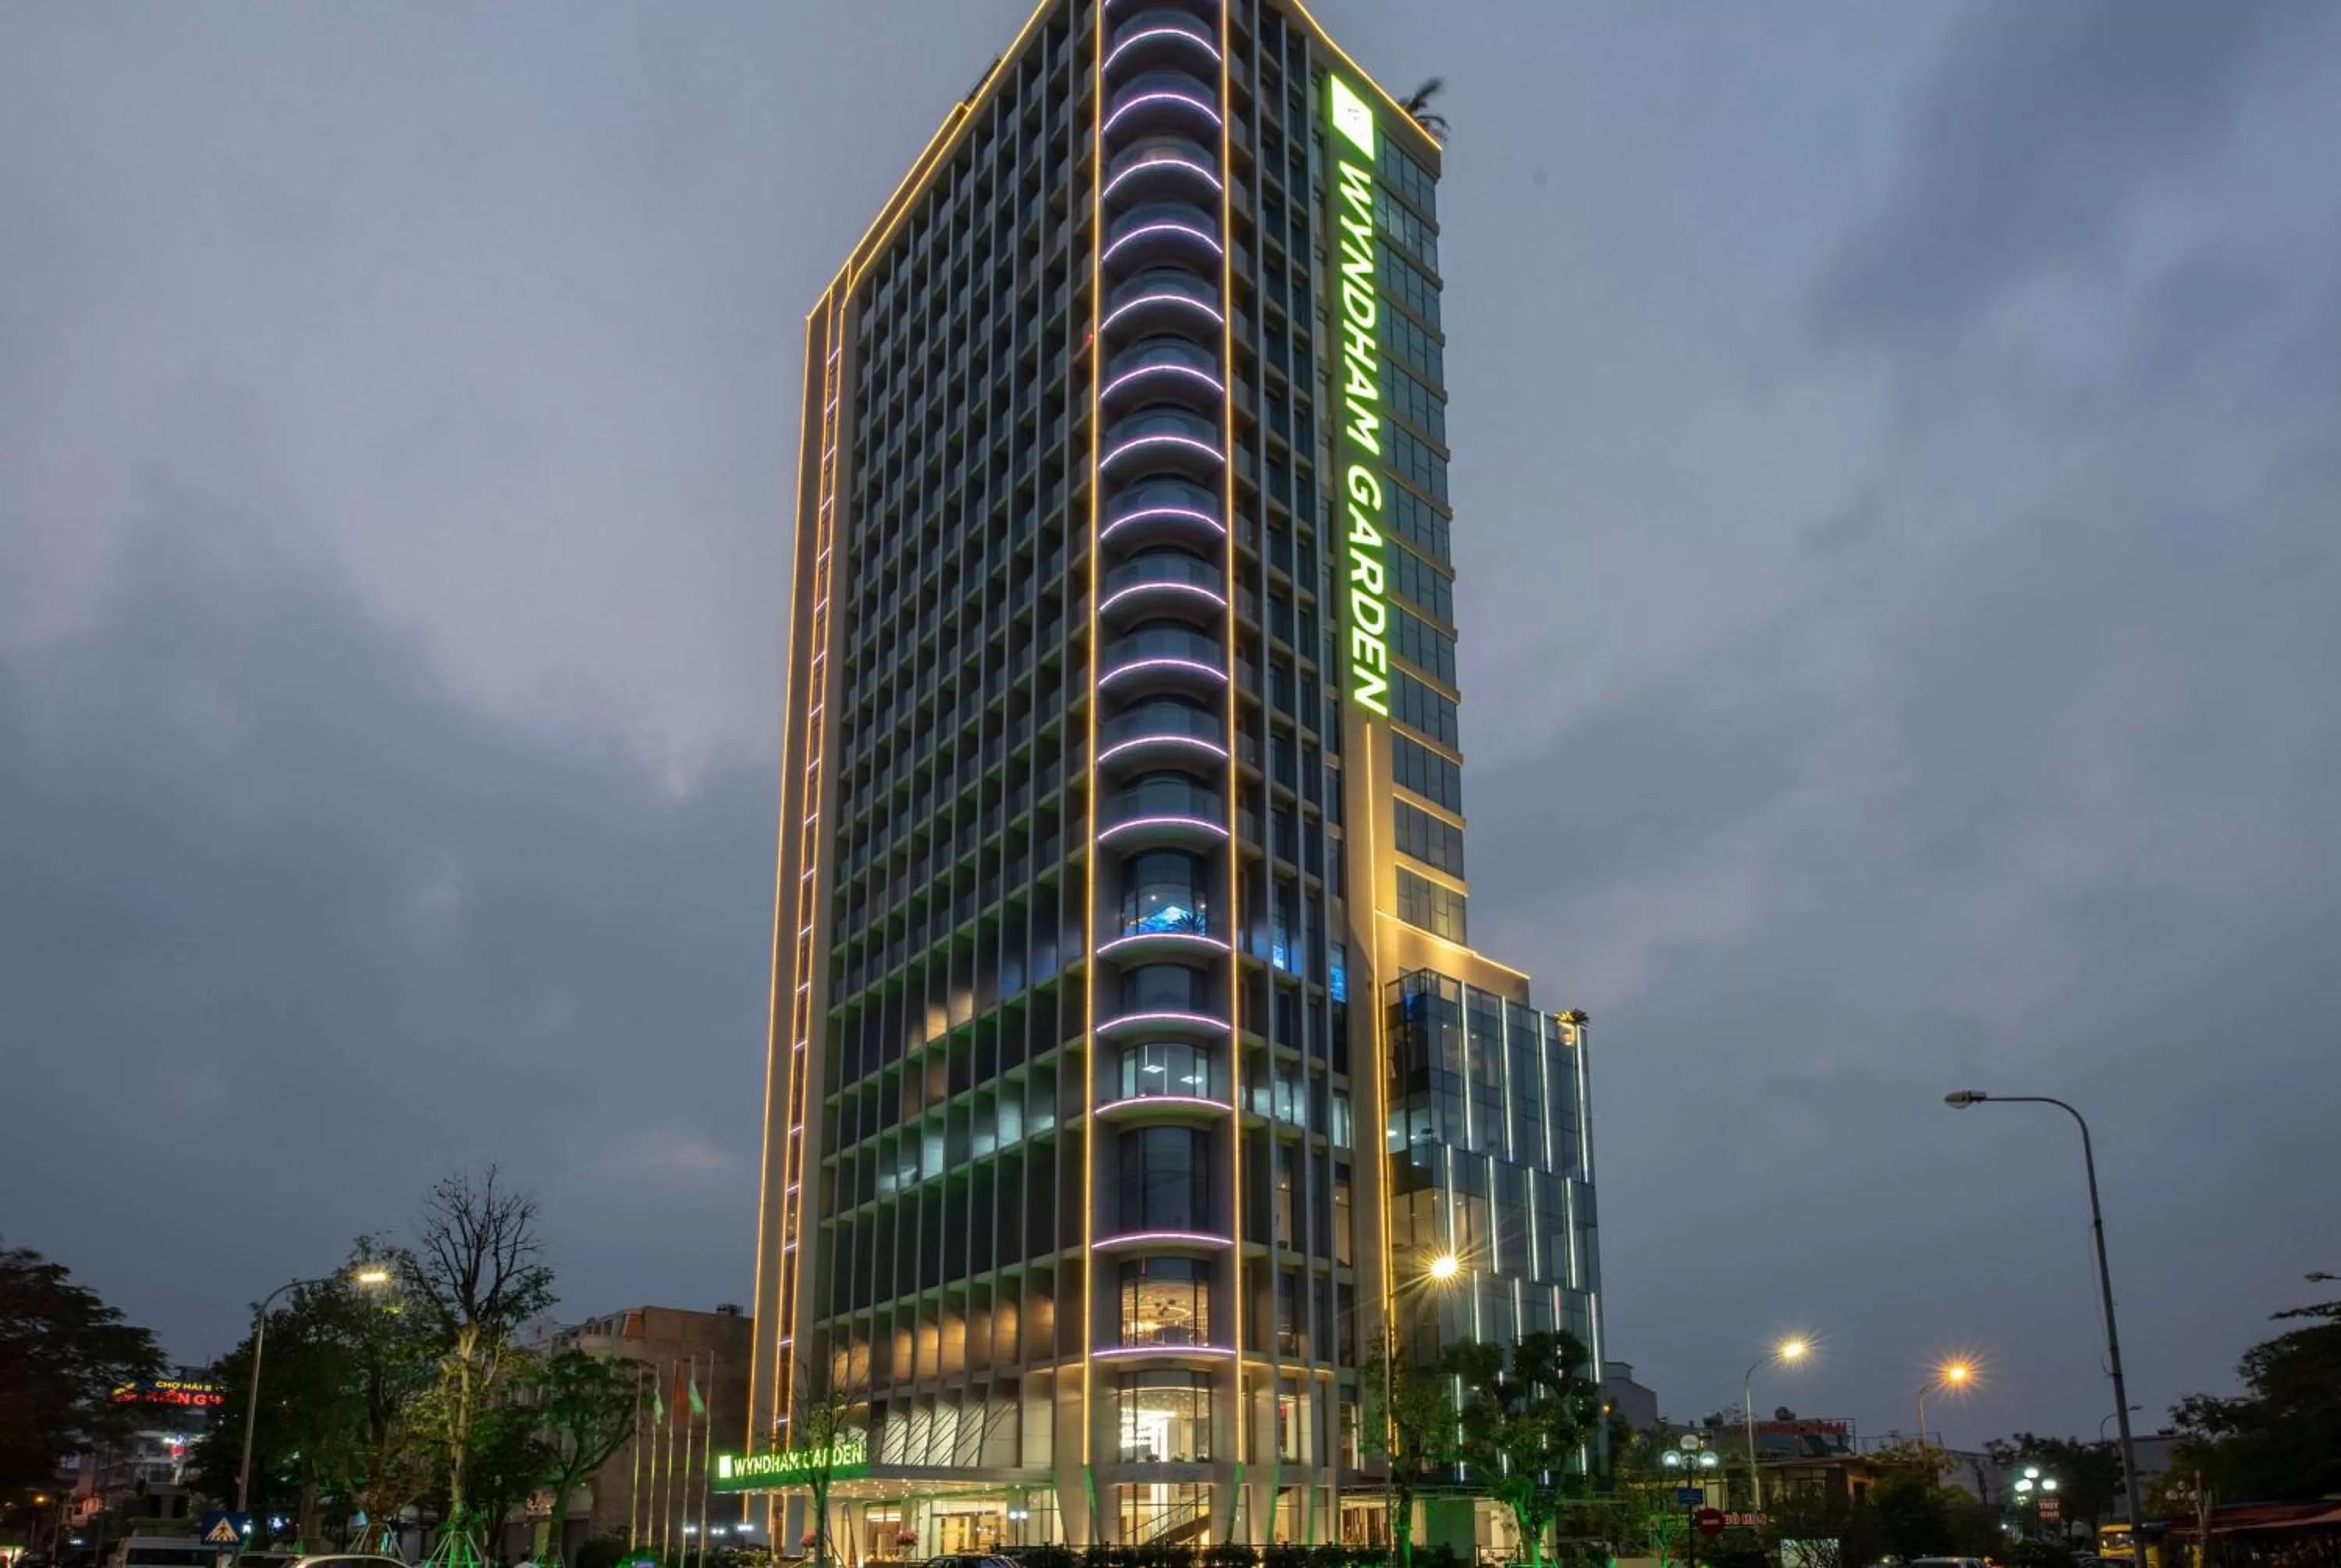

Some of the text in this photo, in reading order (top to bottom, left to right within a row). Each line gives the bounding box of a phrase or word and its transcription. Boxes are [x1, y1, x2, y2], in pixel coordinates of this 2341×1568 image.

[1339, 160, 1388, 717] WYNDHAM GARDEN
[734, 1452, 799, 1477] WYNDHAM
